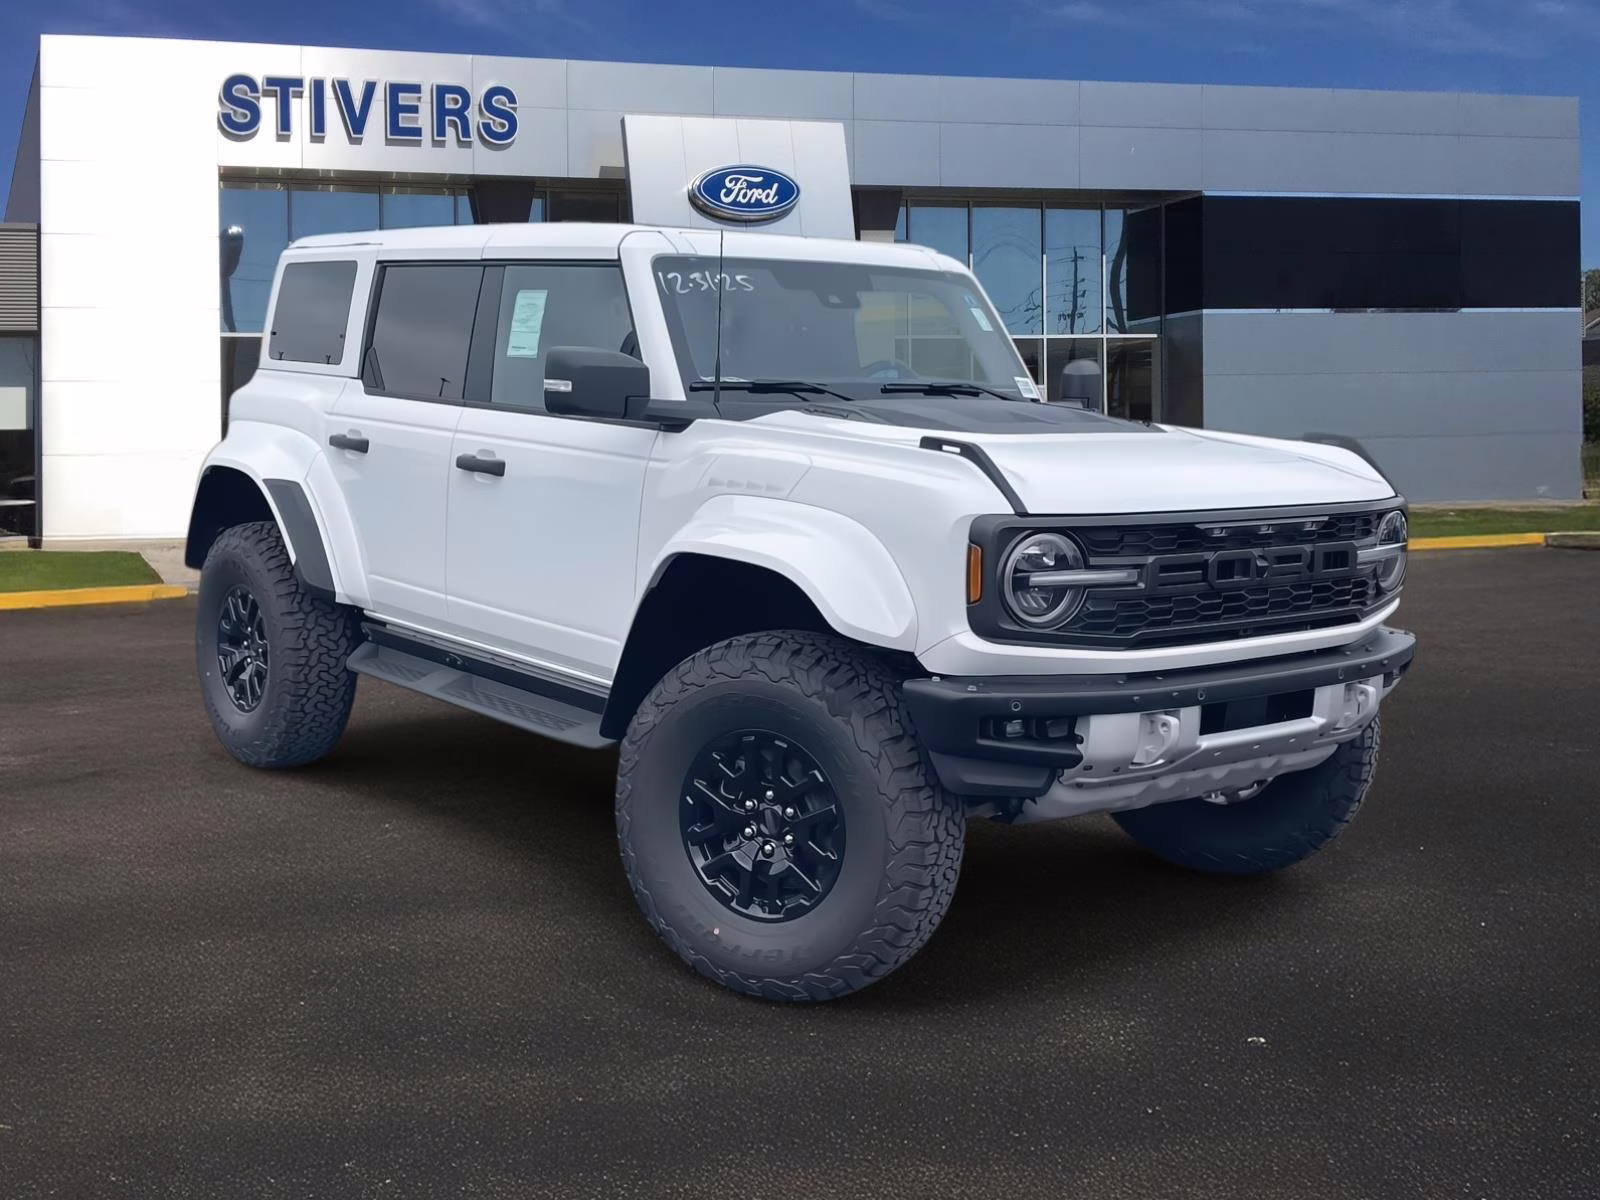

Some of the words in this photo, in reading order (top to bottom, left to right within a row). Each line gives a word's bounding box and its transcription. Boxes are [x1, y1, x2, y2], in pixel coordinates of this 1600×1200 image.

[219, 73, 519, 150] STIVERS
[720, 174, 779, 204] Ford
[1147, 541, 1357, 592] FORD
